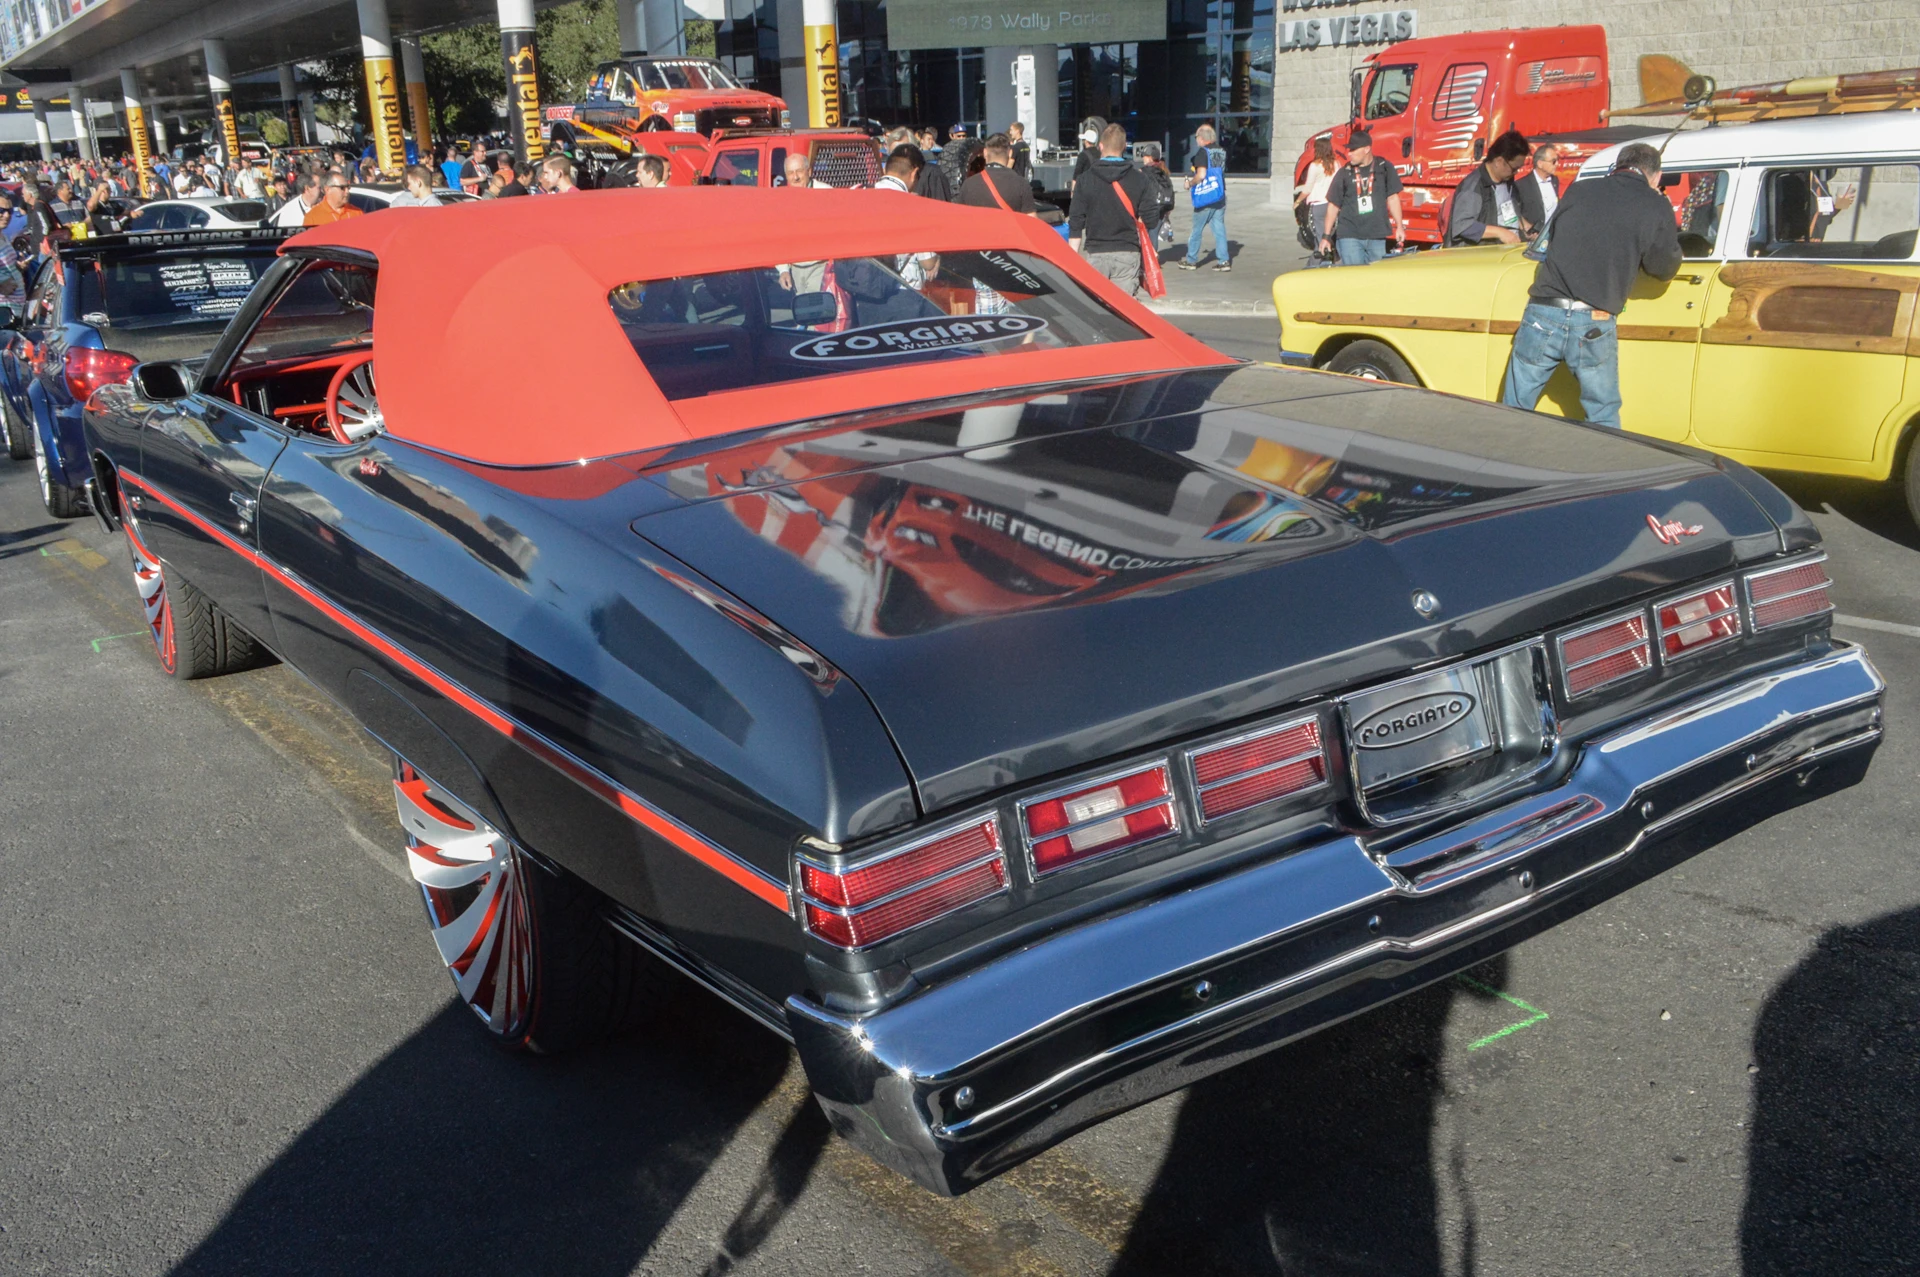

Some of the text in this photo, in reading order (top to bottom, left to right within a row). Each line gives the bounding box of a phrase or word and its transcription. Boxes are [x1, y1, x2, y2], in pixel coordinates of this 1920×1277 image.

[1000, 12, 1051, 31] Wally
[1059, 10, 1112, 27] Parks
[1279, 11, 1413, 53] LAS VEGAS
[653, 60, 711, 69] Firestone
[546, 106, 576, 120] ODYSSEY
[128, 234, 185, 246] BREAK
[251, 228, 283, 239] KILL
[812, 316, 1029, 357] FORGIATO
[897, 335, 974, 351] WHEELS
[1360, 699, 1464, 745] FORGIATO
